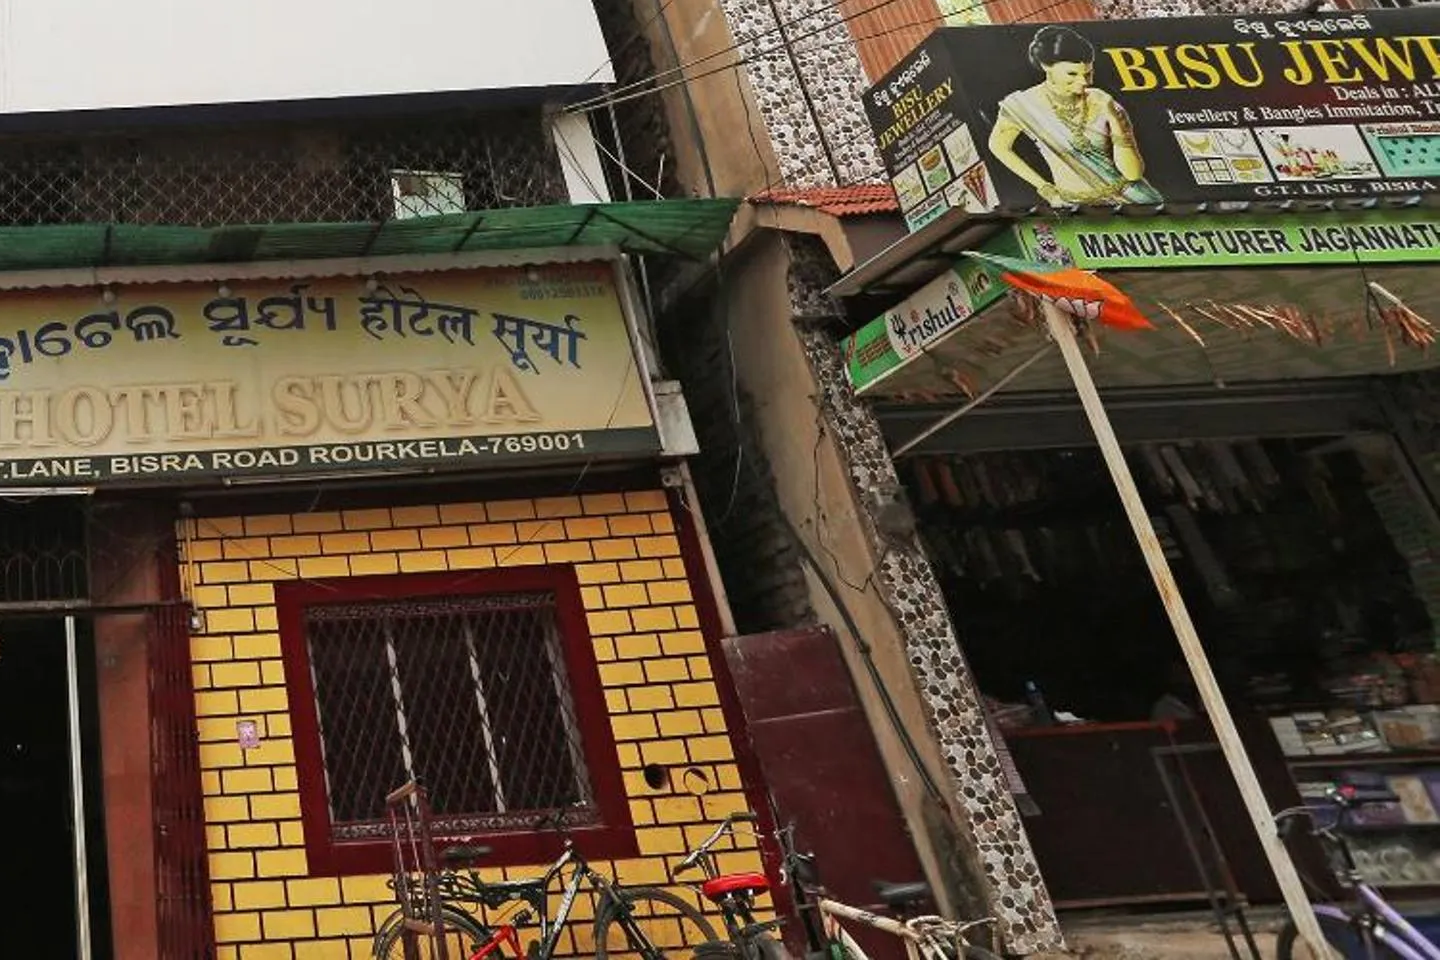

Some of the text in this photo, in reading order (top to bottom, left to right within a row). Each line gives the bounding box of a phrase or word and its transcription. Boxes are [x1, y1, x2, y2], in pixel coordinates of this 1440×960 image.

[1102, 42, 1264, 92] BISU
[891, 84, 924, 118] BISU
[1332, 86, 1380, 101] Deals
[1380, 84, 1399, 99] in
[1413, 82, 1440, 99] AL
[878, 76, 954, 149] JEWELLERY
[1168, 108, 1239, 125] Jewellery
[1243, 107, 1258, 121] &
[1260, 105, 1323, 123] Bangles
[1324, 101, 1422, 118] Immitation,
[1303, 183, 1357, 195] LINE
[1370, 180, 1438, 192] BISRA
[1078, 229, 1293, 259] MANUFACTURER
[273, 367, 542, 437] SURYA
[111, 453, 204, 475] BISRA
[212, 448, 300, 470] ROAD
[310, 432, 586, 465] ROURKELA-769001
